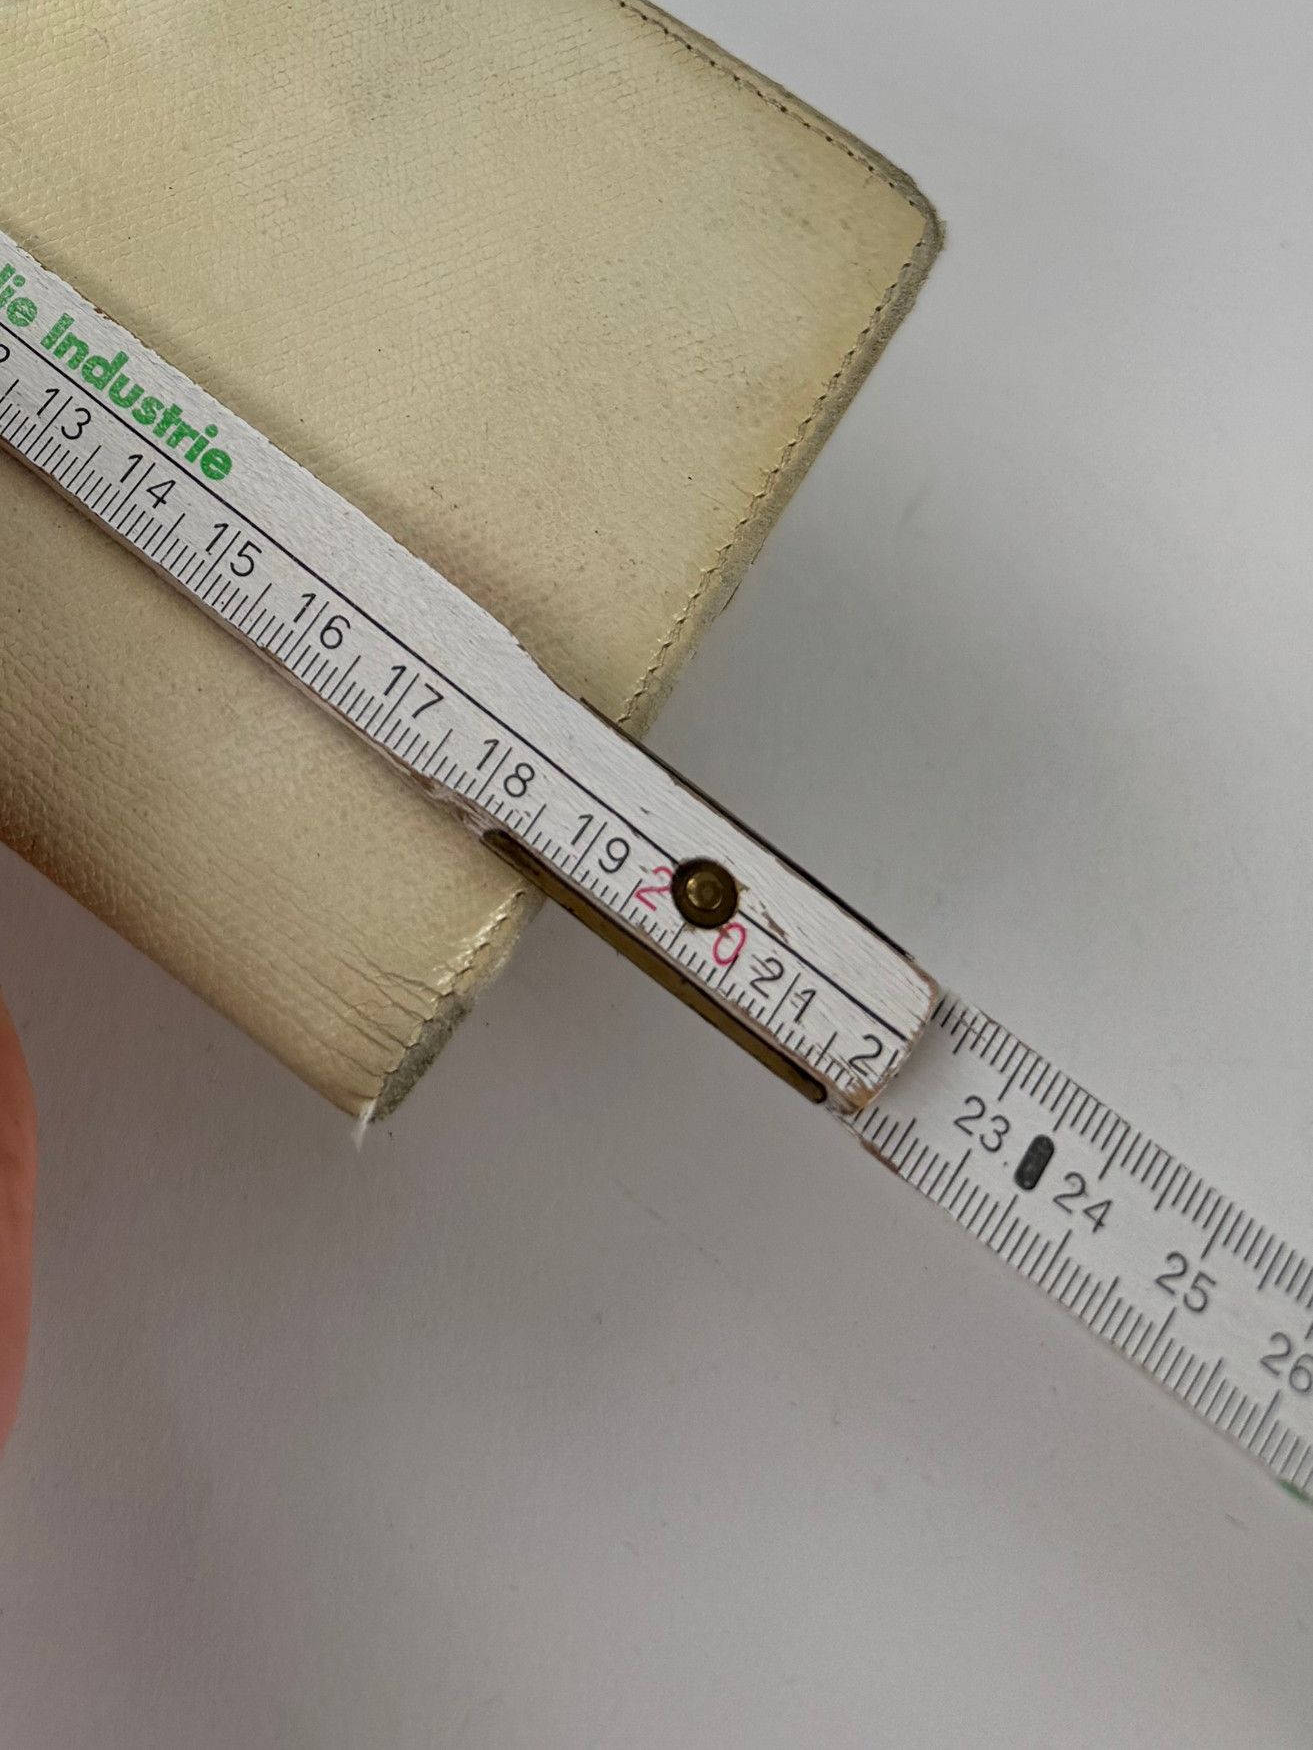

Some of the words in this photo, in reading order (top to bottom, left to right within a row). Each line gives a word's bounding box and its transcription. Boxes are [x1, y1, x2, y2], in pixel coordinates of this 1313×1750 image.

[40, 313, 233, 481] Industrie
[37, 388, 92, 440] 13
[119, 454, 177, 509] 14
[205, 522, 263, 577] 15
[293, 592, 351, 650] 16
[383, 664, 445, 719] 17
[476, 738, 536, 798] 18
[570, 813, 631, 874] 19
[633, 865, 747, 967] 20
[750, 957, 816, 1023] 21
[953, 1095, 1011, 1153] 23
[1053, 1172, 1113, 1234] 24
[1155, 1252, 1217, 1313] 25
[1259, 1331, 1313, 1393] 26
